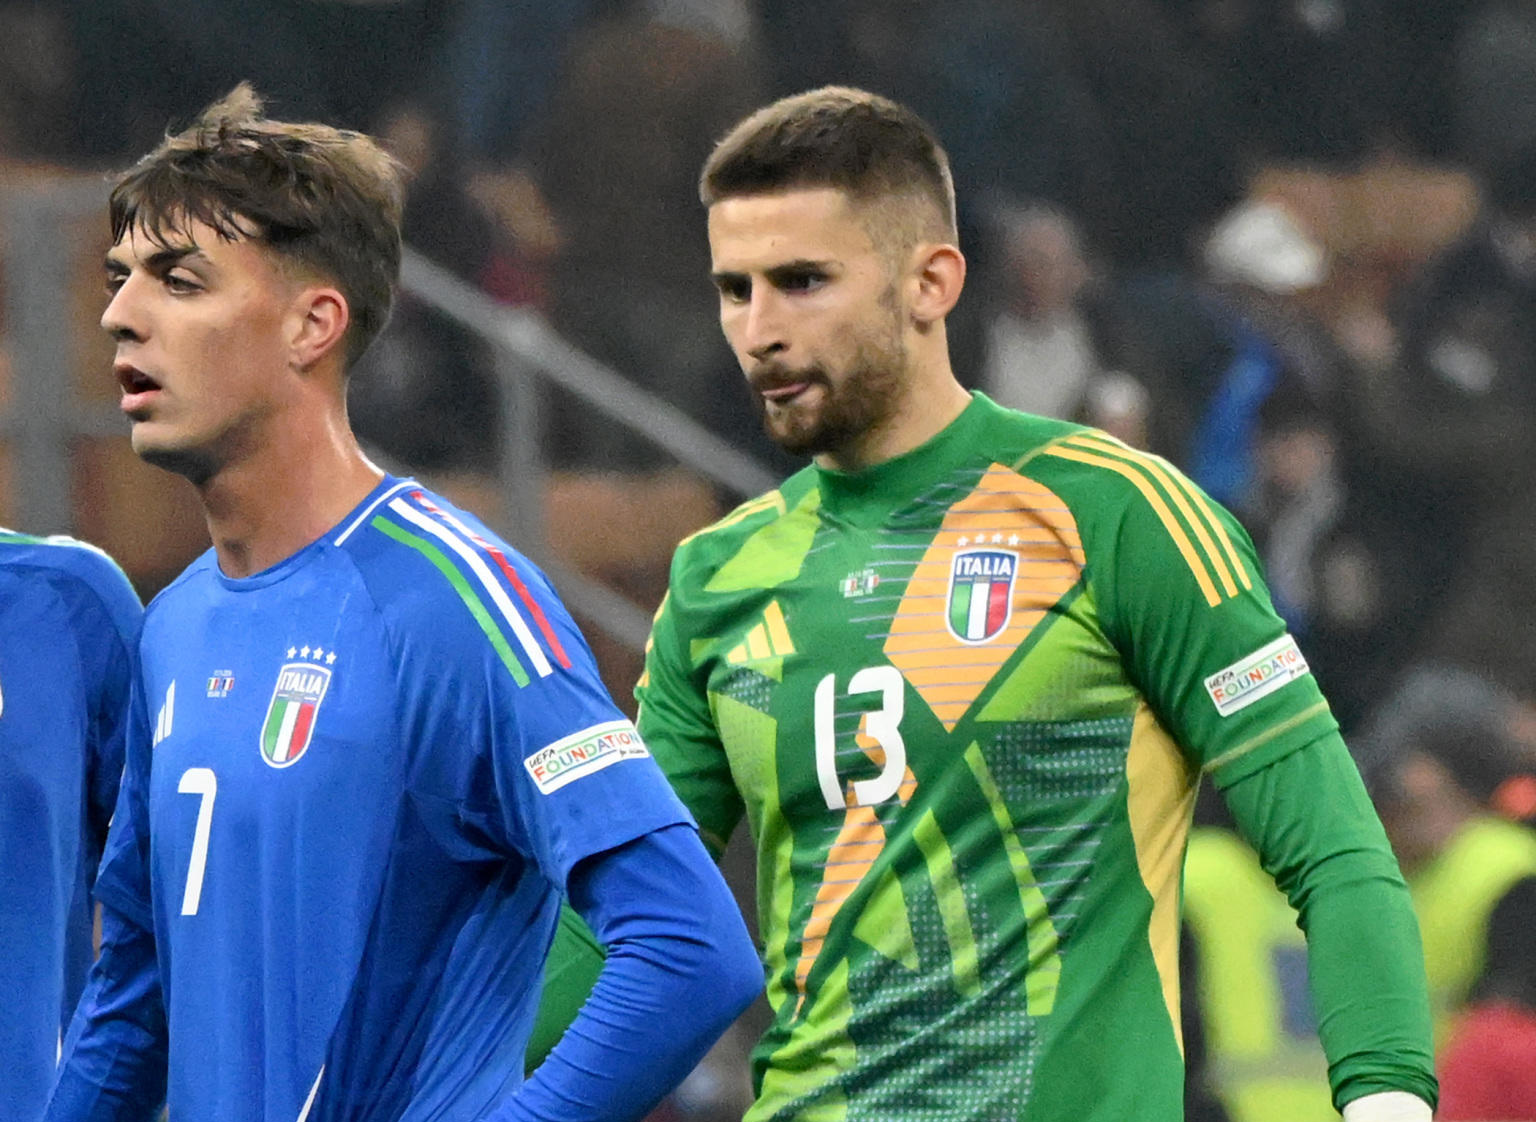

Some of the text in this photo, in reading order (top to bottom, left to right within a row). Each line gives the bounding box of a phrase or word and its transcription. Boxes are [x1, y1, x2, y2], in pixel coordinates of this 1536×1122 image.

[955, 556, 1013, 577] ITALIA
[279, 671, 324, 695] ITALIA
[1208, 671, 1235, 689] UEFA
[815, 666, 906, 809] 13
[529, 748, 557, 769] UEFA
[533, 731, 641, 782] FOUNDATION
[178, 768, 216, 915] 7
